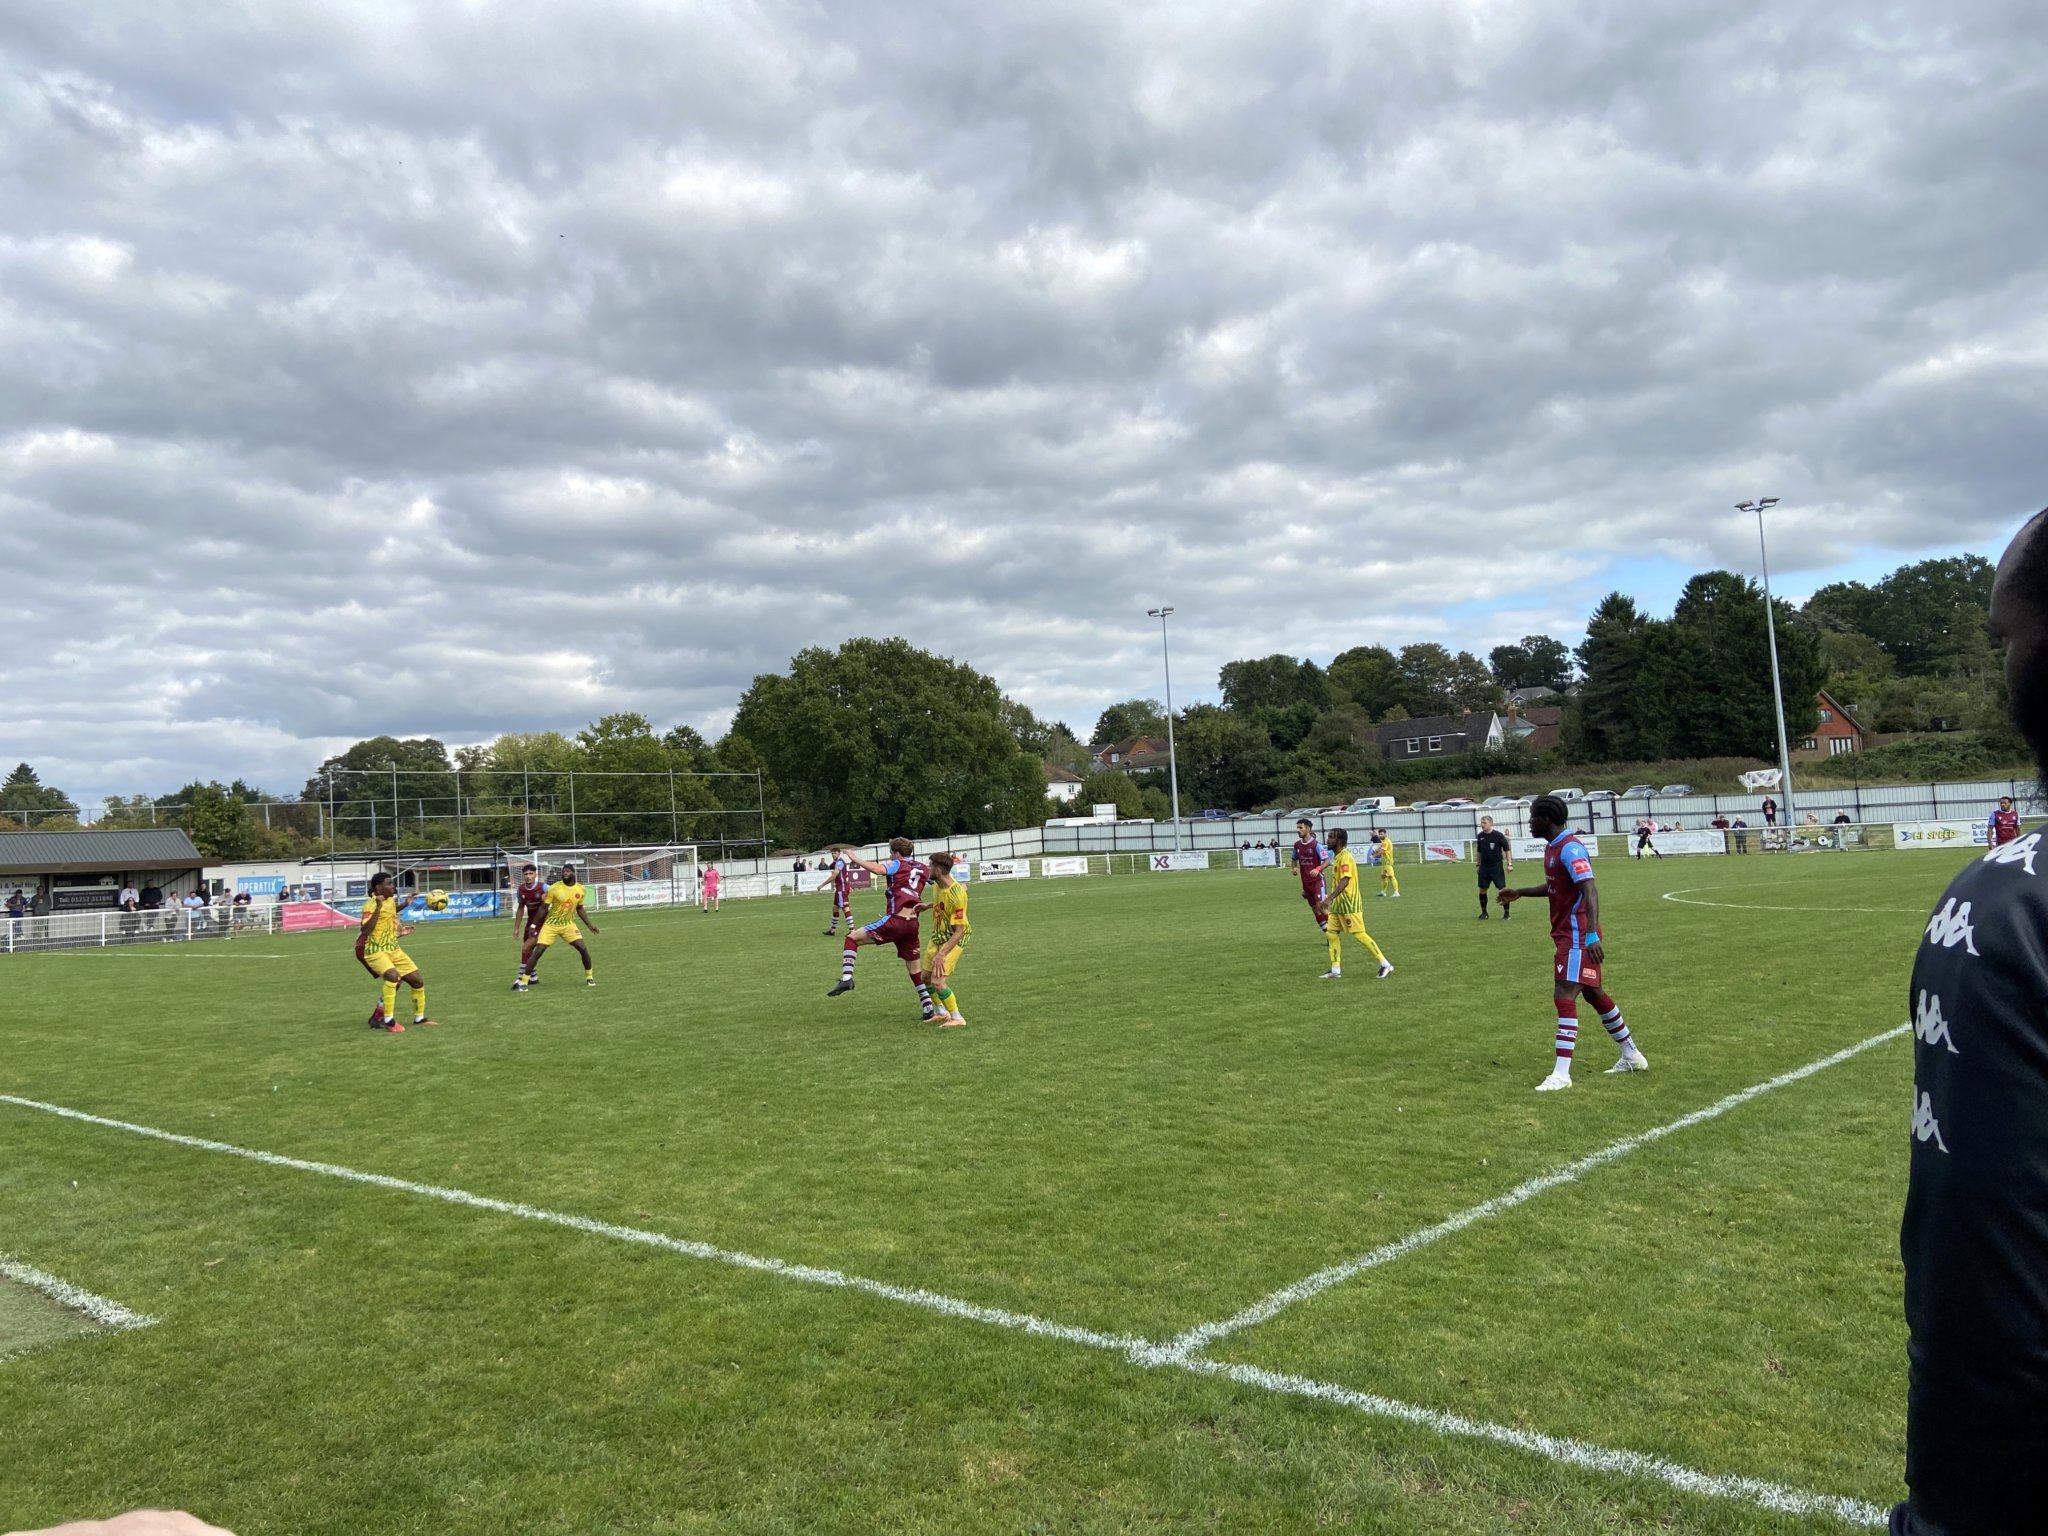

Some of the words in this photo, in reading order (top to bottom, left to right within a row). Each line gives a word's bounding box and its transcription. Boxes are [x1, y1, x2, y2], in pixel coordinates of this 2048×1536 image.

[1927, 830, 1957, 840] SPEED
[238, 879, 277, 894] OPERATIX
[623, 891, 684, 902] mindset4sportnt
